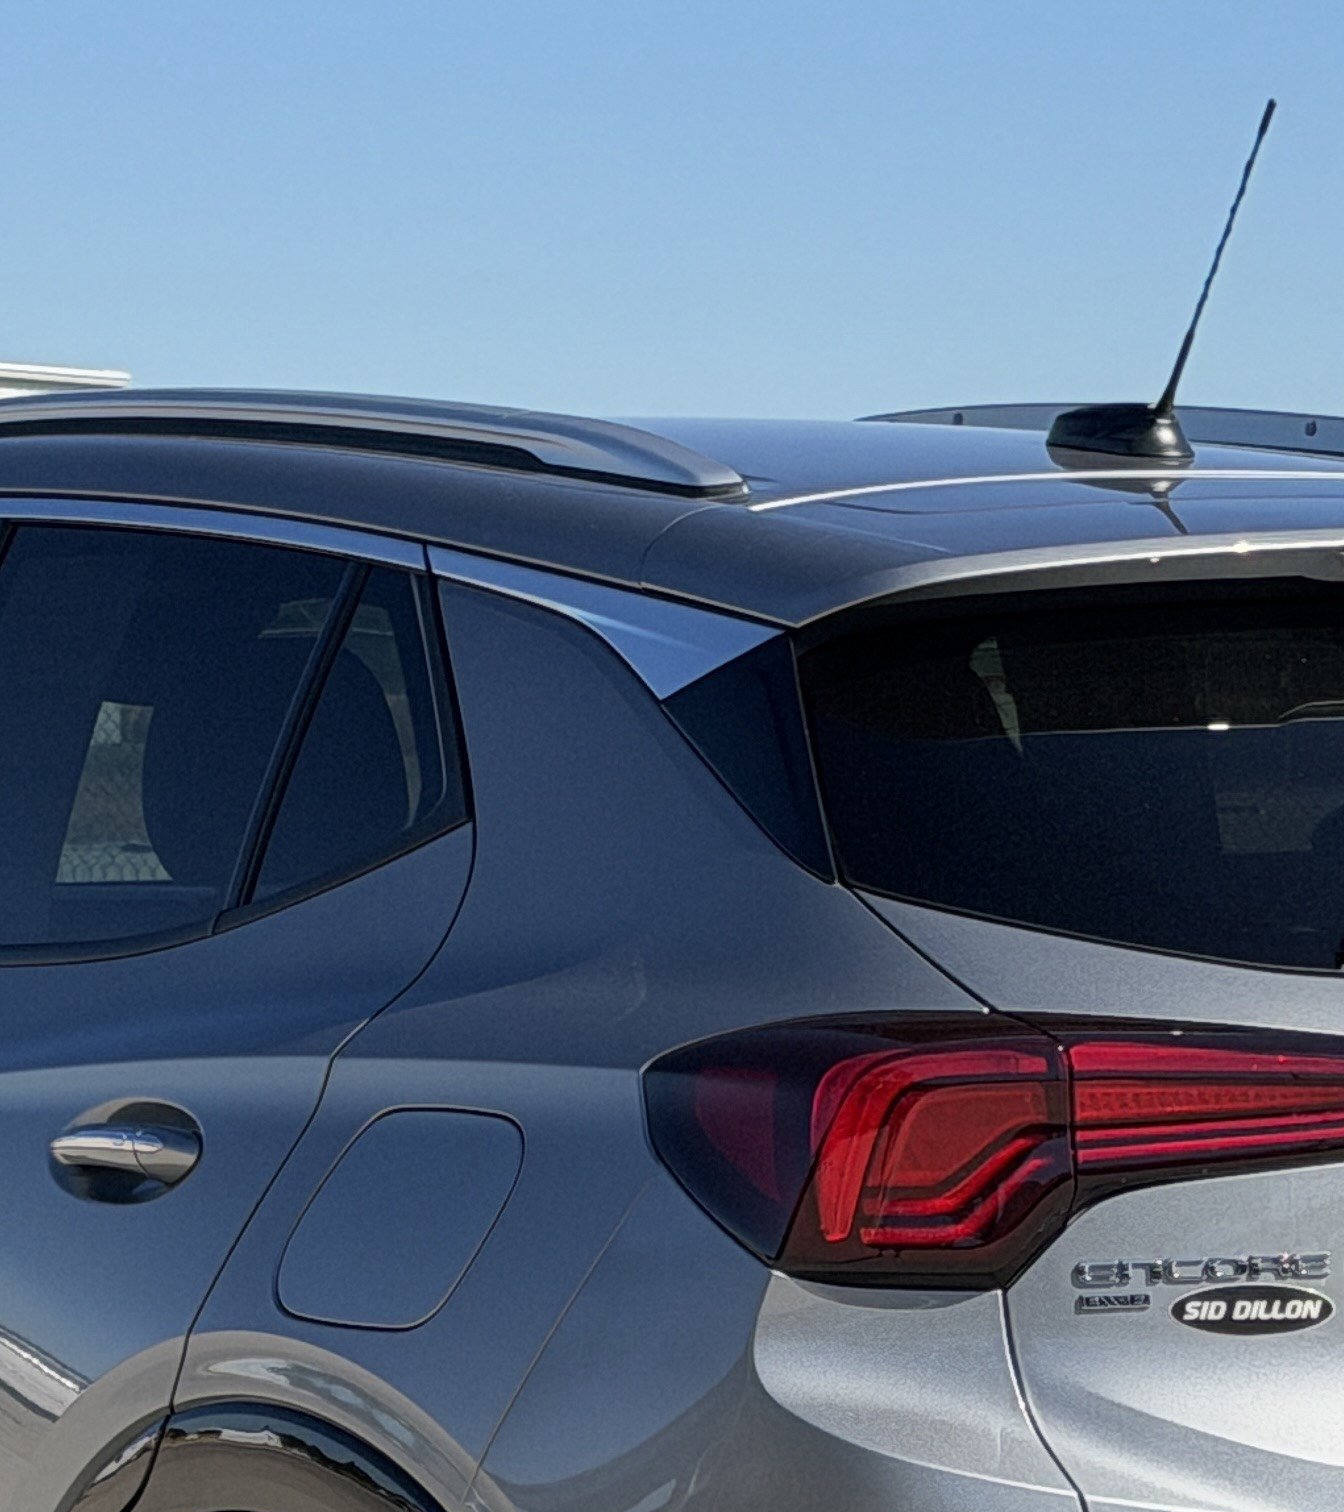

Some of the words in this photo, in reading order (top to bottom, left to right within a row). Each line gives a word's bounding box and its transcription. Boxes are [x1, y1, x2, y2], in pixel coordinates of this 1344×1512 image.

[1071, 1251, 1332, 1289] ENCORE
[1183, 1301, 1227, 1320] SID
[1232, 1300, 1321, 1320] DILLON
